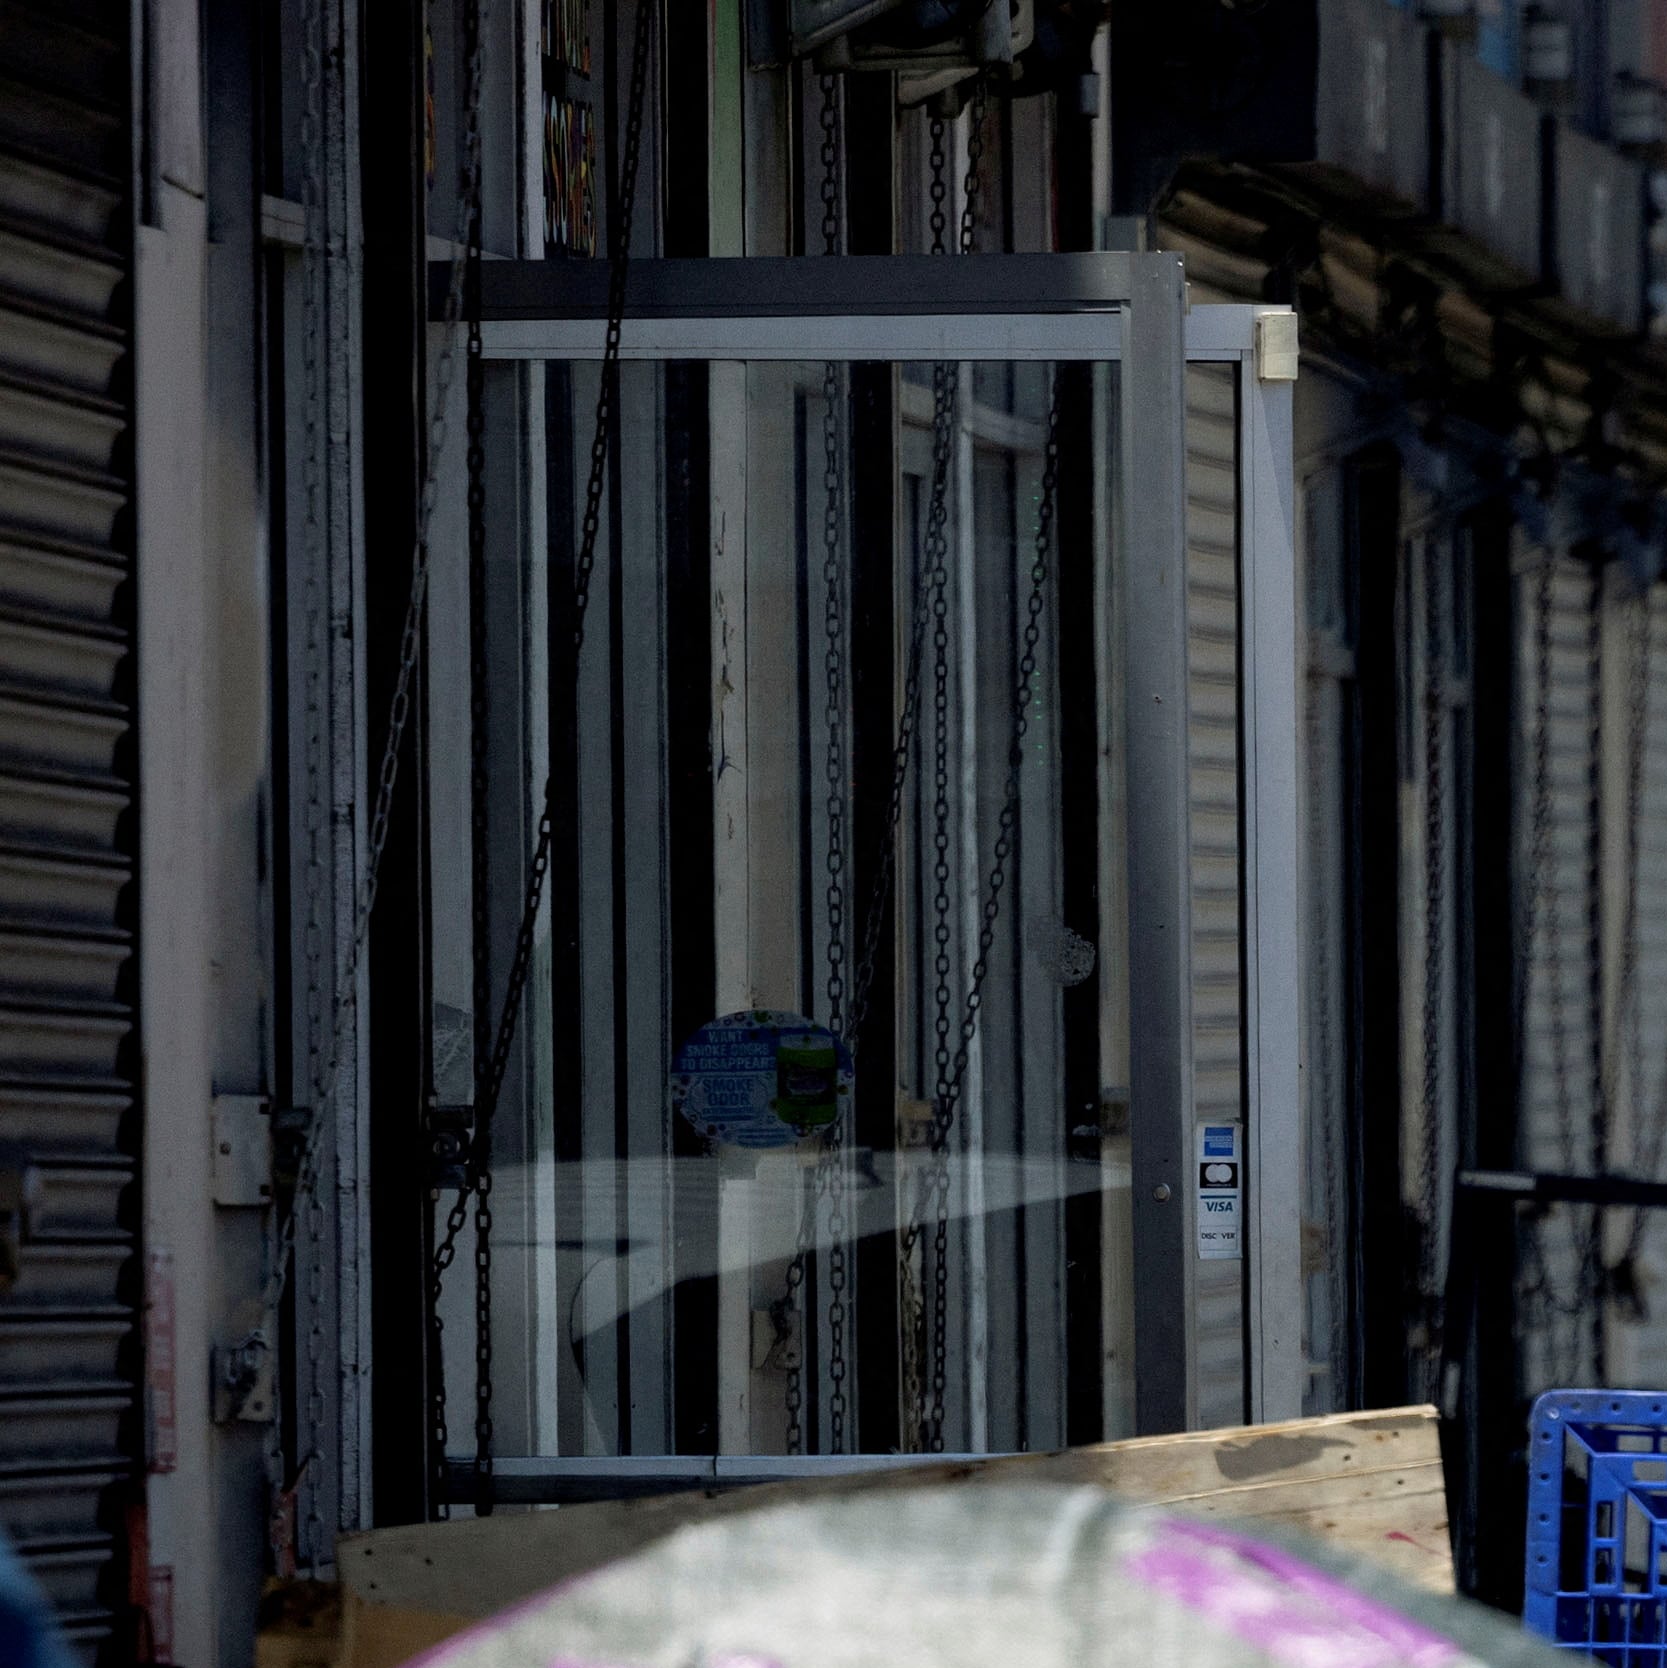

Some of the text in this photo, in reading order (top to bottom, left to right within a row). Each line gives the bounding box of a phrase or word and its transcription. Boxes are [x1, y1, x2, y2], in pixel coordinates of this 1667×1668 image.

[709, 1030, 744, 1043] WANT
[686, 1044, 728, 1057] SMOKE
[680, 1057, 696, 1070] TO
[703, 1079, 754, 1093] SMOKE
[707, 1093, 750, 1106] ODOR
[1206, 1202, 1234, 1212] VISA
[1201, 1232, 1236, 1240] DISCVER
